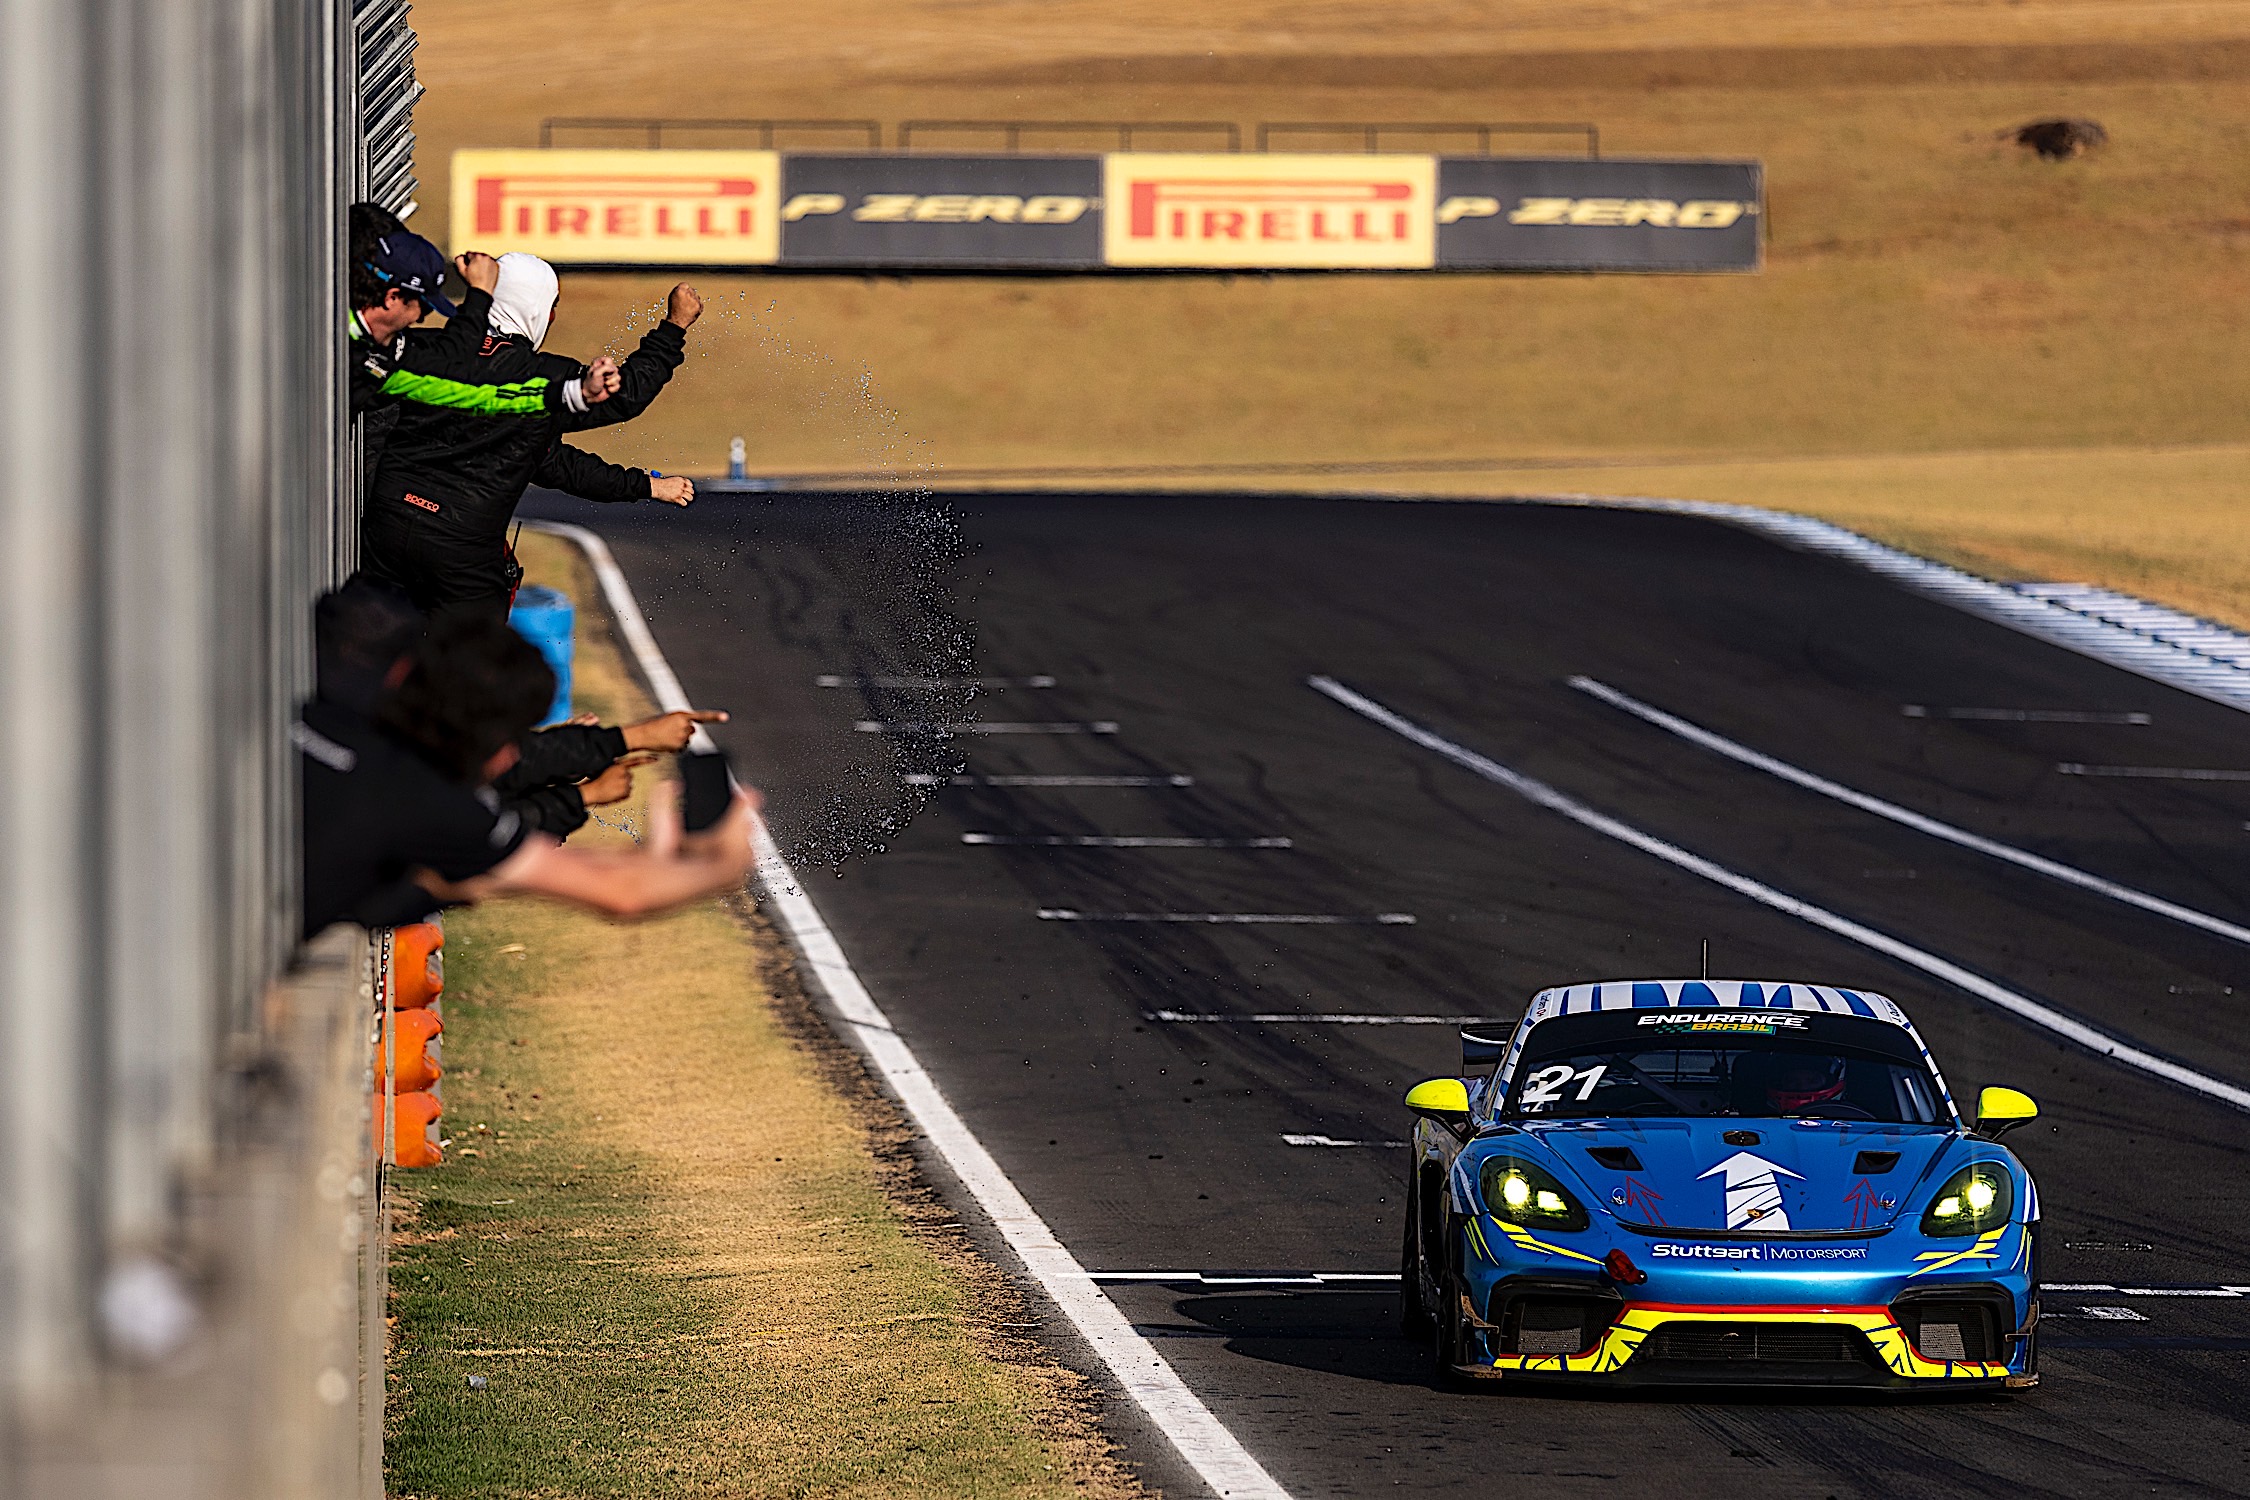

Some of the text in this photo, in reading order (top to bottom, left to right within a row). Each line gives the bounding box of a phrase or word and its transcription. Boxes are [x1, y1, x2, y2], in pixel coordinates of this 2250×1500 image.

[475, 175, 757, 236] PIRELLI
[781, 193, 1089, 223] P ZERO
[1129, 178, 1412, 240] PIRELLI
[1436, 196, 1744, 228] P ZERO
[1637, 1013, 1805, 1027] ENDURANCE
[1691, 1022, 1770, 1032] BRASIL
[1521, 1065, 1607, 1104] 21
[1652, 1244, 1867, 1259] Stuttgart MOTORSPORT
